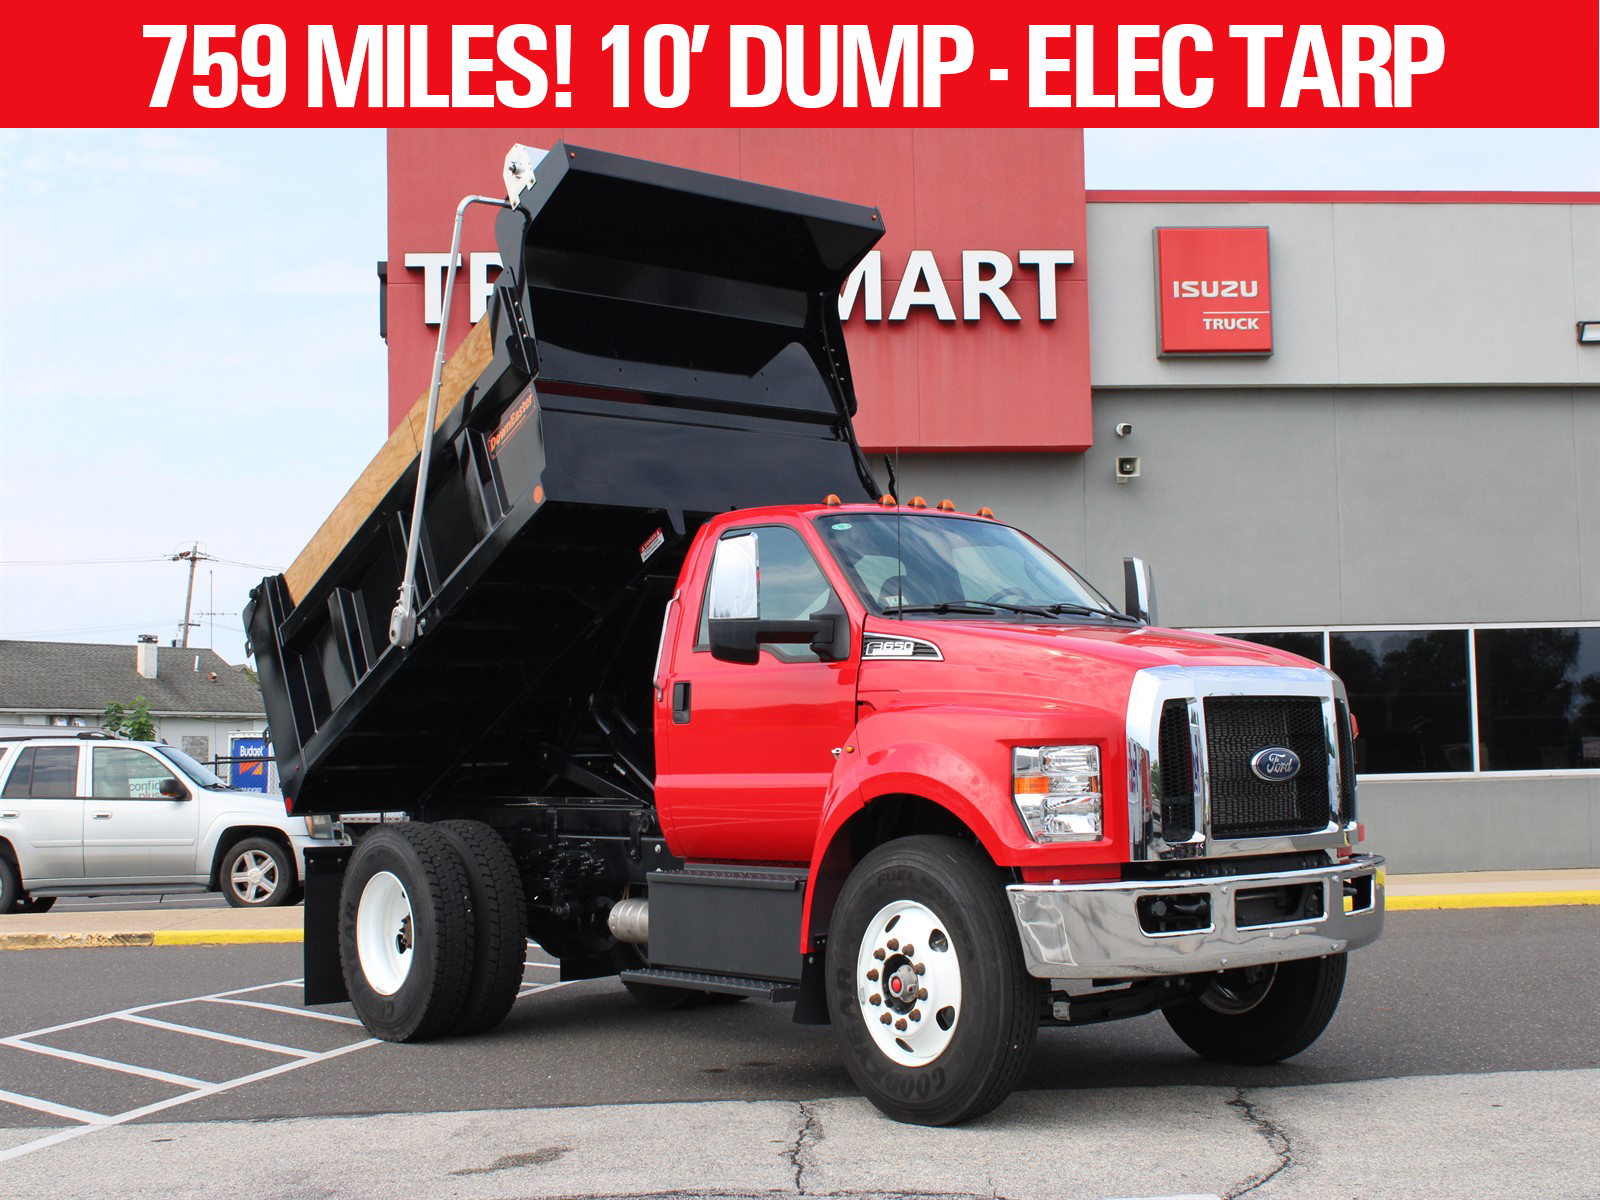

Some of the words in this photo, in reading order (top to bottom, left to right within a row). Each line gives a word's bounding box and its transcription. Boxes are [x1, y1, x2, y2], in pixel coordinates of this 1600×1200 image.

[1173, 281, 1258, 298] ISUZU
[1203, 318, 1260, 330] TRUCK
[1266, 753, 1293, 774] Ford
[129, 780, 160, 792] confid
